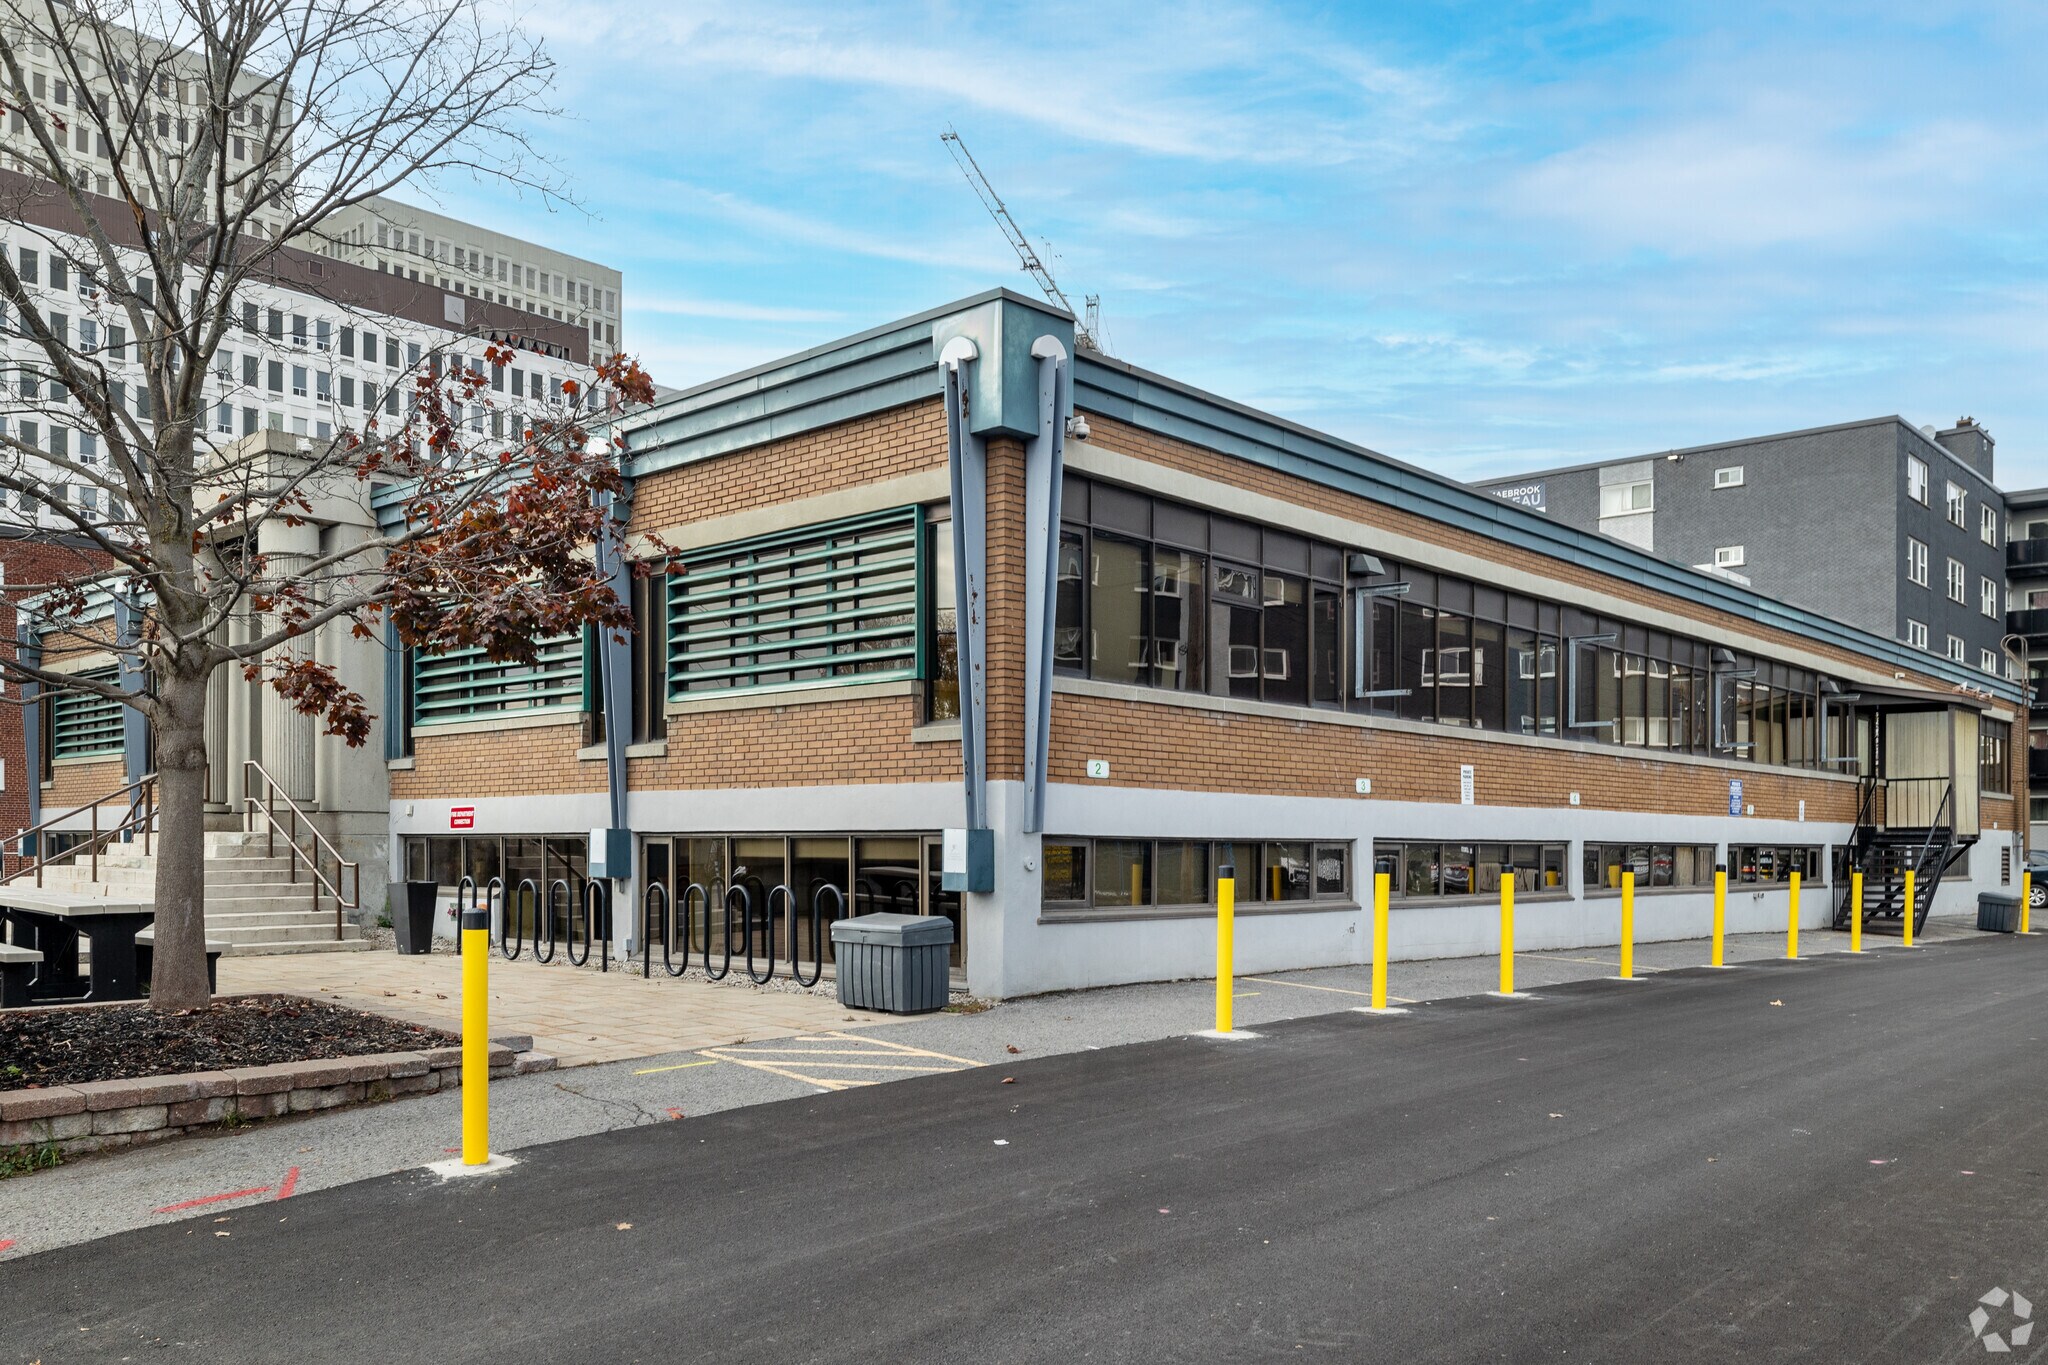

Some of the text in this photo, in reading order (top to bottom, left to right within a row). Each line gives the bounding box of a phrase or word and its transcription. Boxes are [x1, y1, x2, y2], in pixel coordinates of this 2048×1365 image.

[1492, 485, 1541, 498] AEBROOK
[1095, 762, 1102, 775] 2
[1360, 780, 1367, 791] 3
